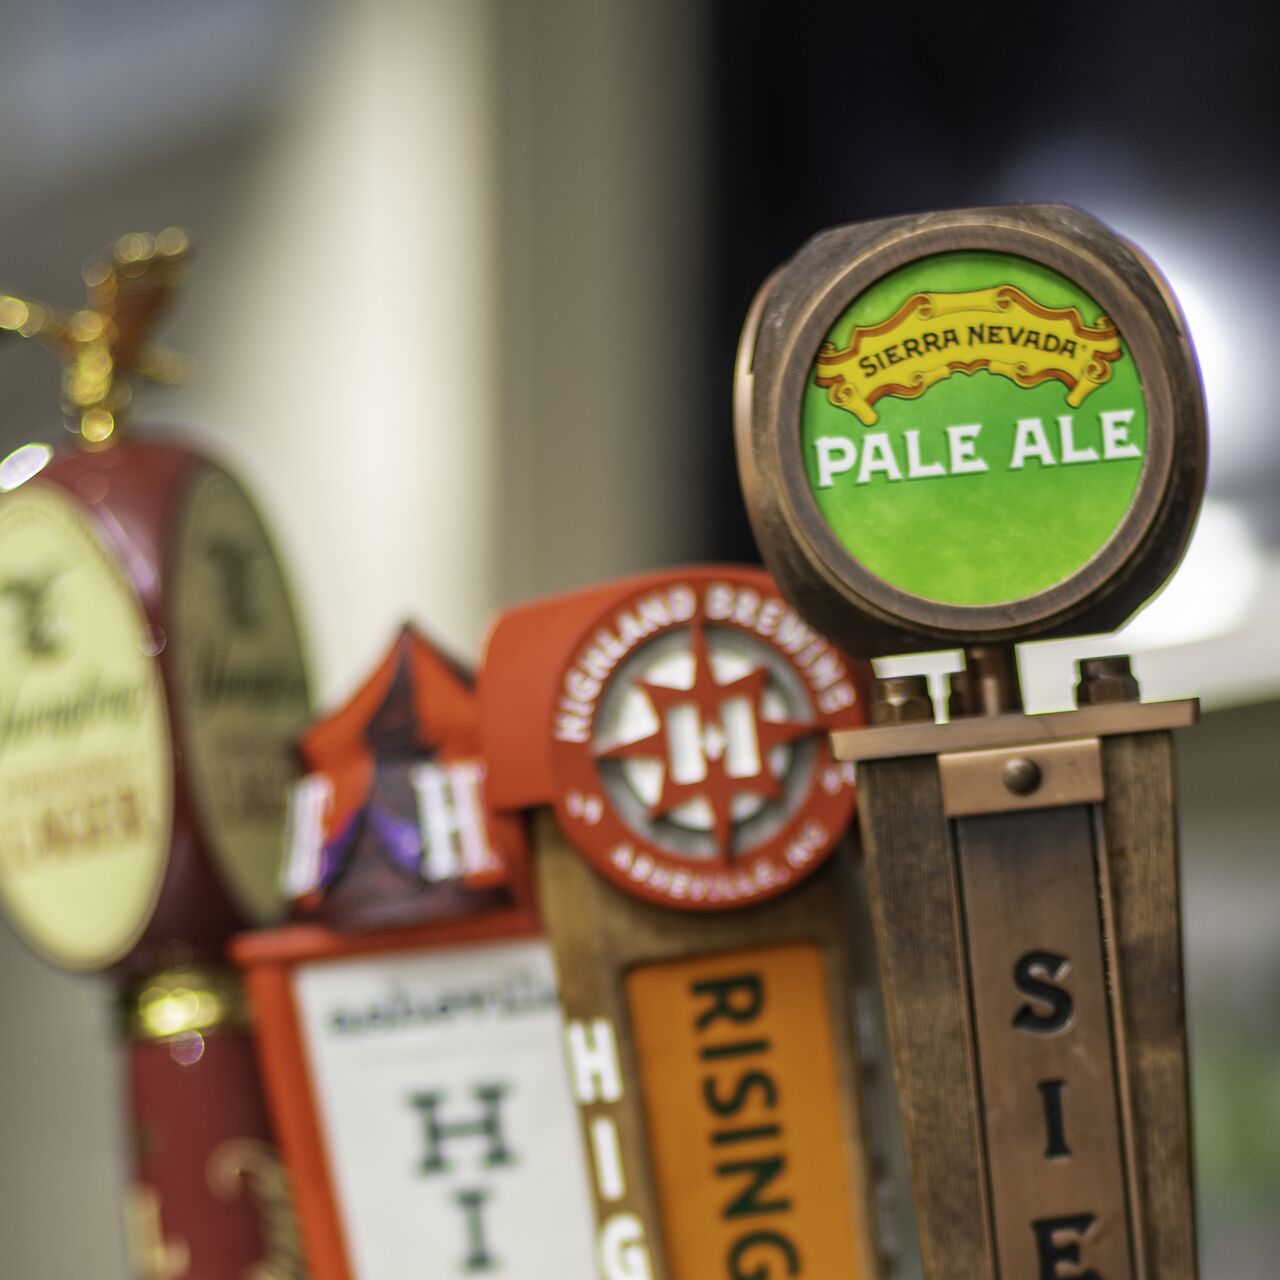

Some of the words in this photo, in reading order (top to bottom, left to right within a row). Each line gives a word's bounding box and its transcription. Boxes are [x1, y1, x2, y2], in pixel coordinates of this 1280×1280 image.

[858, 328, 961, 378] SIERRA
[968, 323, 1079, 360] NEVADA
[814, 422, 990, 488] PALE
[1009, 408, 1141, 468] ALE
[553, 584, 698, 744] HIGHLAND
[705, 582, 858, 714] BREWING
